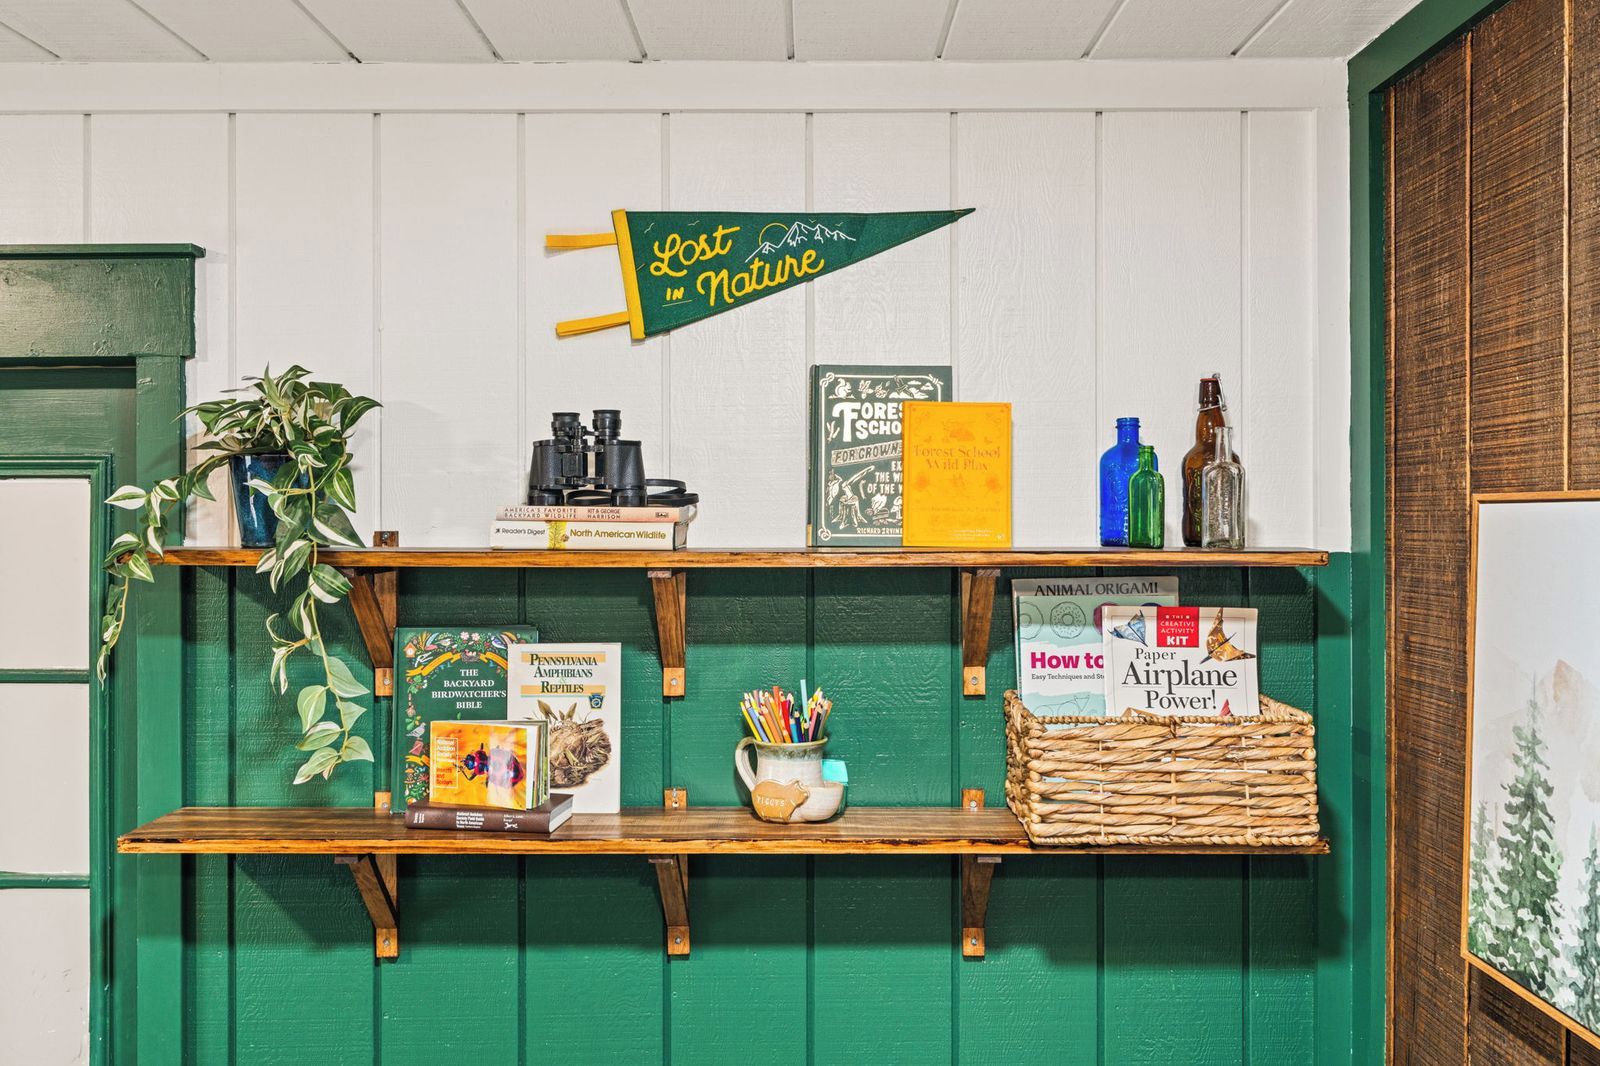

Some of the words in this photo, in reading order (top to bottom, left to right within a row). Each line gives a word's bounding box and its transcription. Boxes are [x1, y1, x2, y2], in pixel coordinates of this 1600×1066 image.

[650, 224, 741, 278] Lost
[666, 286, 685, 301] IN
[696, 250, 825, 306] Nature
[834, 449, 856, 463] FOR
[914, 445, 955, 457] Forest
[958, 446, 1001, 458] School
[926, 459, 959, 470] Wild
[964, 459, 990, 472] Play
[874, 472, 890, 483] THE
[867, 483, 878, 494] OF
[879, 483, 895, 494] THE
[570, 529, 593, 537] North
[594, 530, 635, 538] American
[636, 530, 666, 539] Wildlife
[1034, 584, 1092, 596] ANIMAL
[1095, 582, 1158, 594] ORIGAMI
[1166, 636, 1189, 646] KIT
[530, 653, 598, 666] PENNSYLVANIA
[1030, 652, 1080, 669] How
[1084, 652, 1104, 669] to
[1135, 648, 1177, 664] Paper
[534, 665, 593, 678] AMPHIBIANS
[1122, 660, 1238, 696] Airplane
[444, 680, 495, 688] BACKYARD
[540, 680, 584, 693] REPTILES
[432, 690, 507, 698] BIRDWATCHER'S
[1144, 689, 1216, 710] Power!
